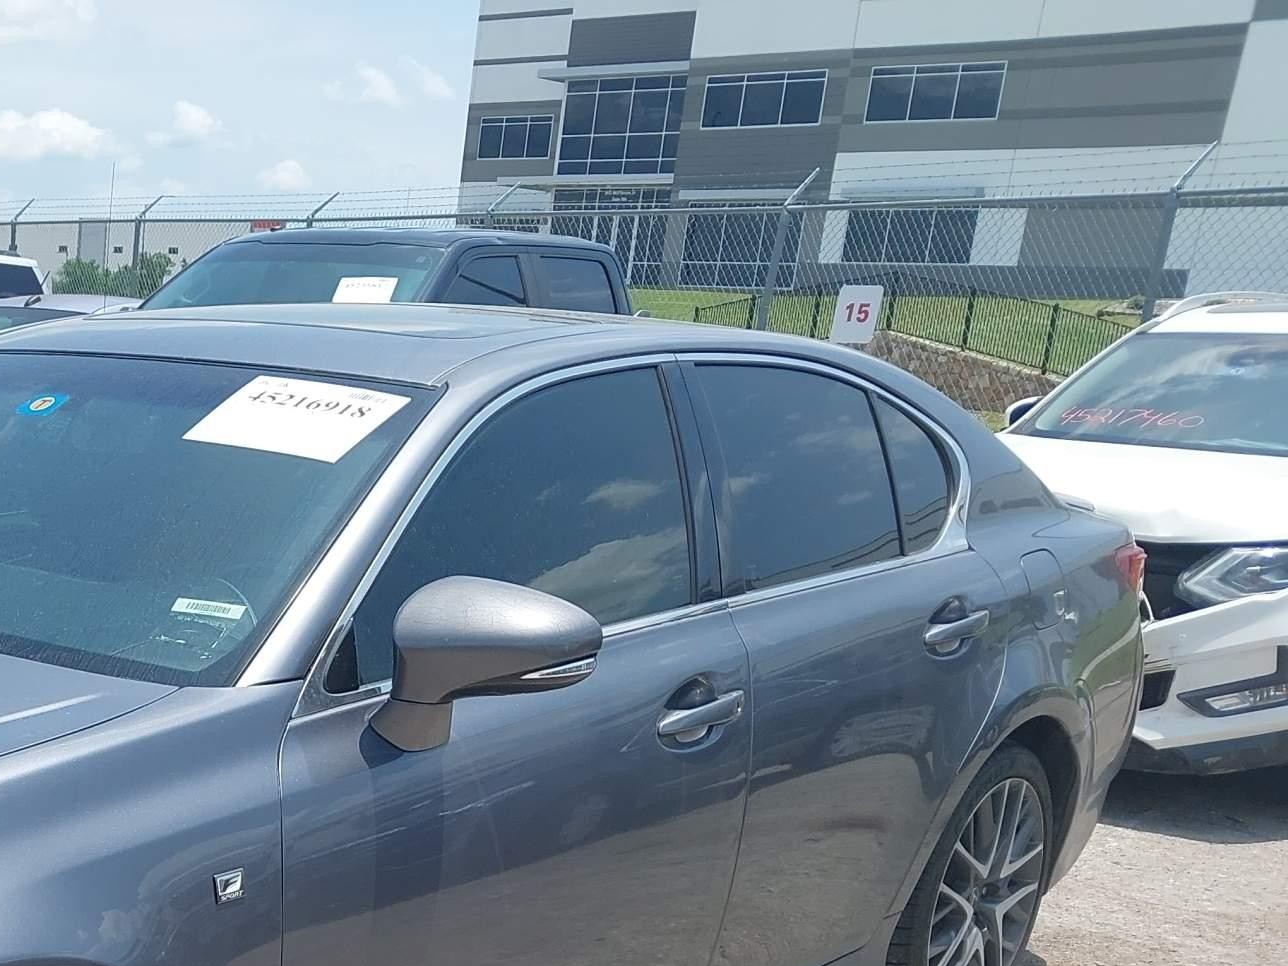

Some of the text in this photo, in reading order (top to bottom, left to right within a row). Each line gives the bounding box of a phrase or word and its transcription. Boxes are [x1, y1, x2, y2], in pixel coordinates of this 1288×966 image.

[845, 302, 871, 323] 15
[248, 390, 372, 418] 45216918
[1060, 406, 1205, 429] 45217460
[220, 889, 244, 901] SPORT
